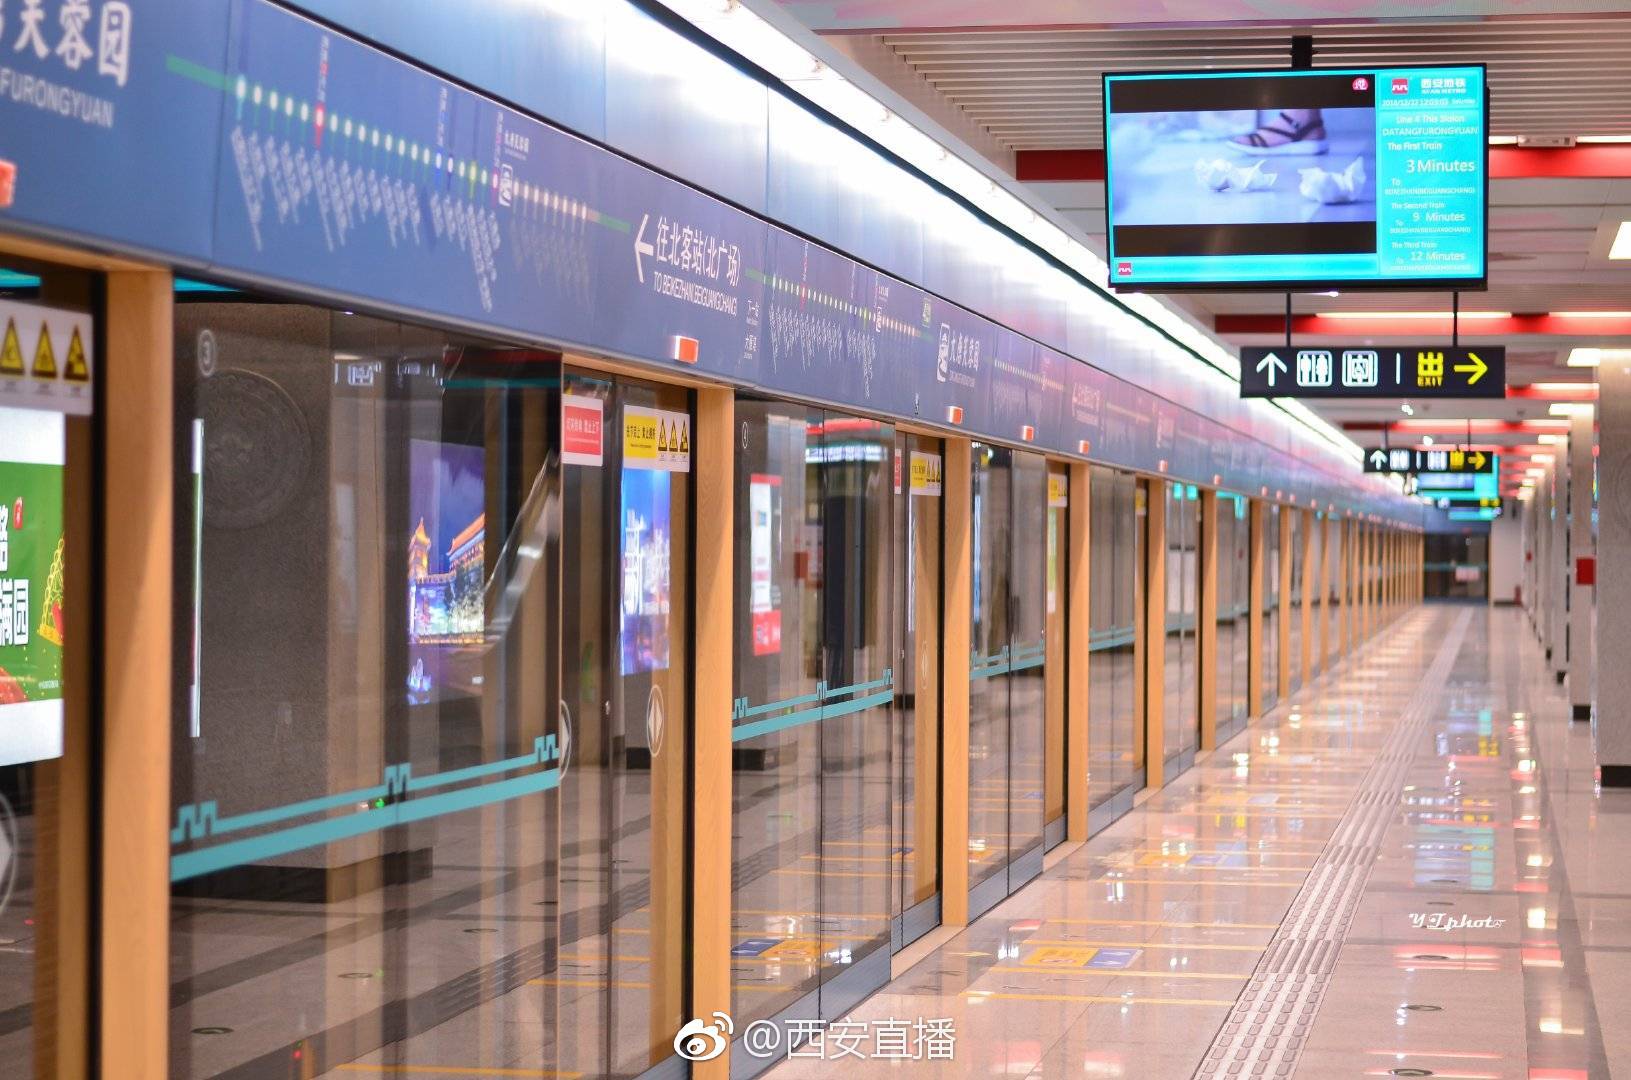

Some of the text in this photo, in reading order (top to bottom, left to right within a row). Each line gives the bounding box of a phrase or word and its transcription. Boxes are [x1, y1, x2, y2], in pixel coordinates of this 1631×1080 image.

[0, 0, 131, 87] 芙蓉园
[1406, 159, 1475, 173] 3 Minutes
[1412, 212, 1466, 222] 9 Minutes
[1411, 251, 1466, 261] 12 Minutes
[654, 271, 662, 293] TO
[1417, 376, 1442, 387] EXIT
